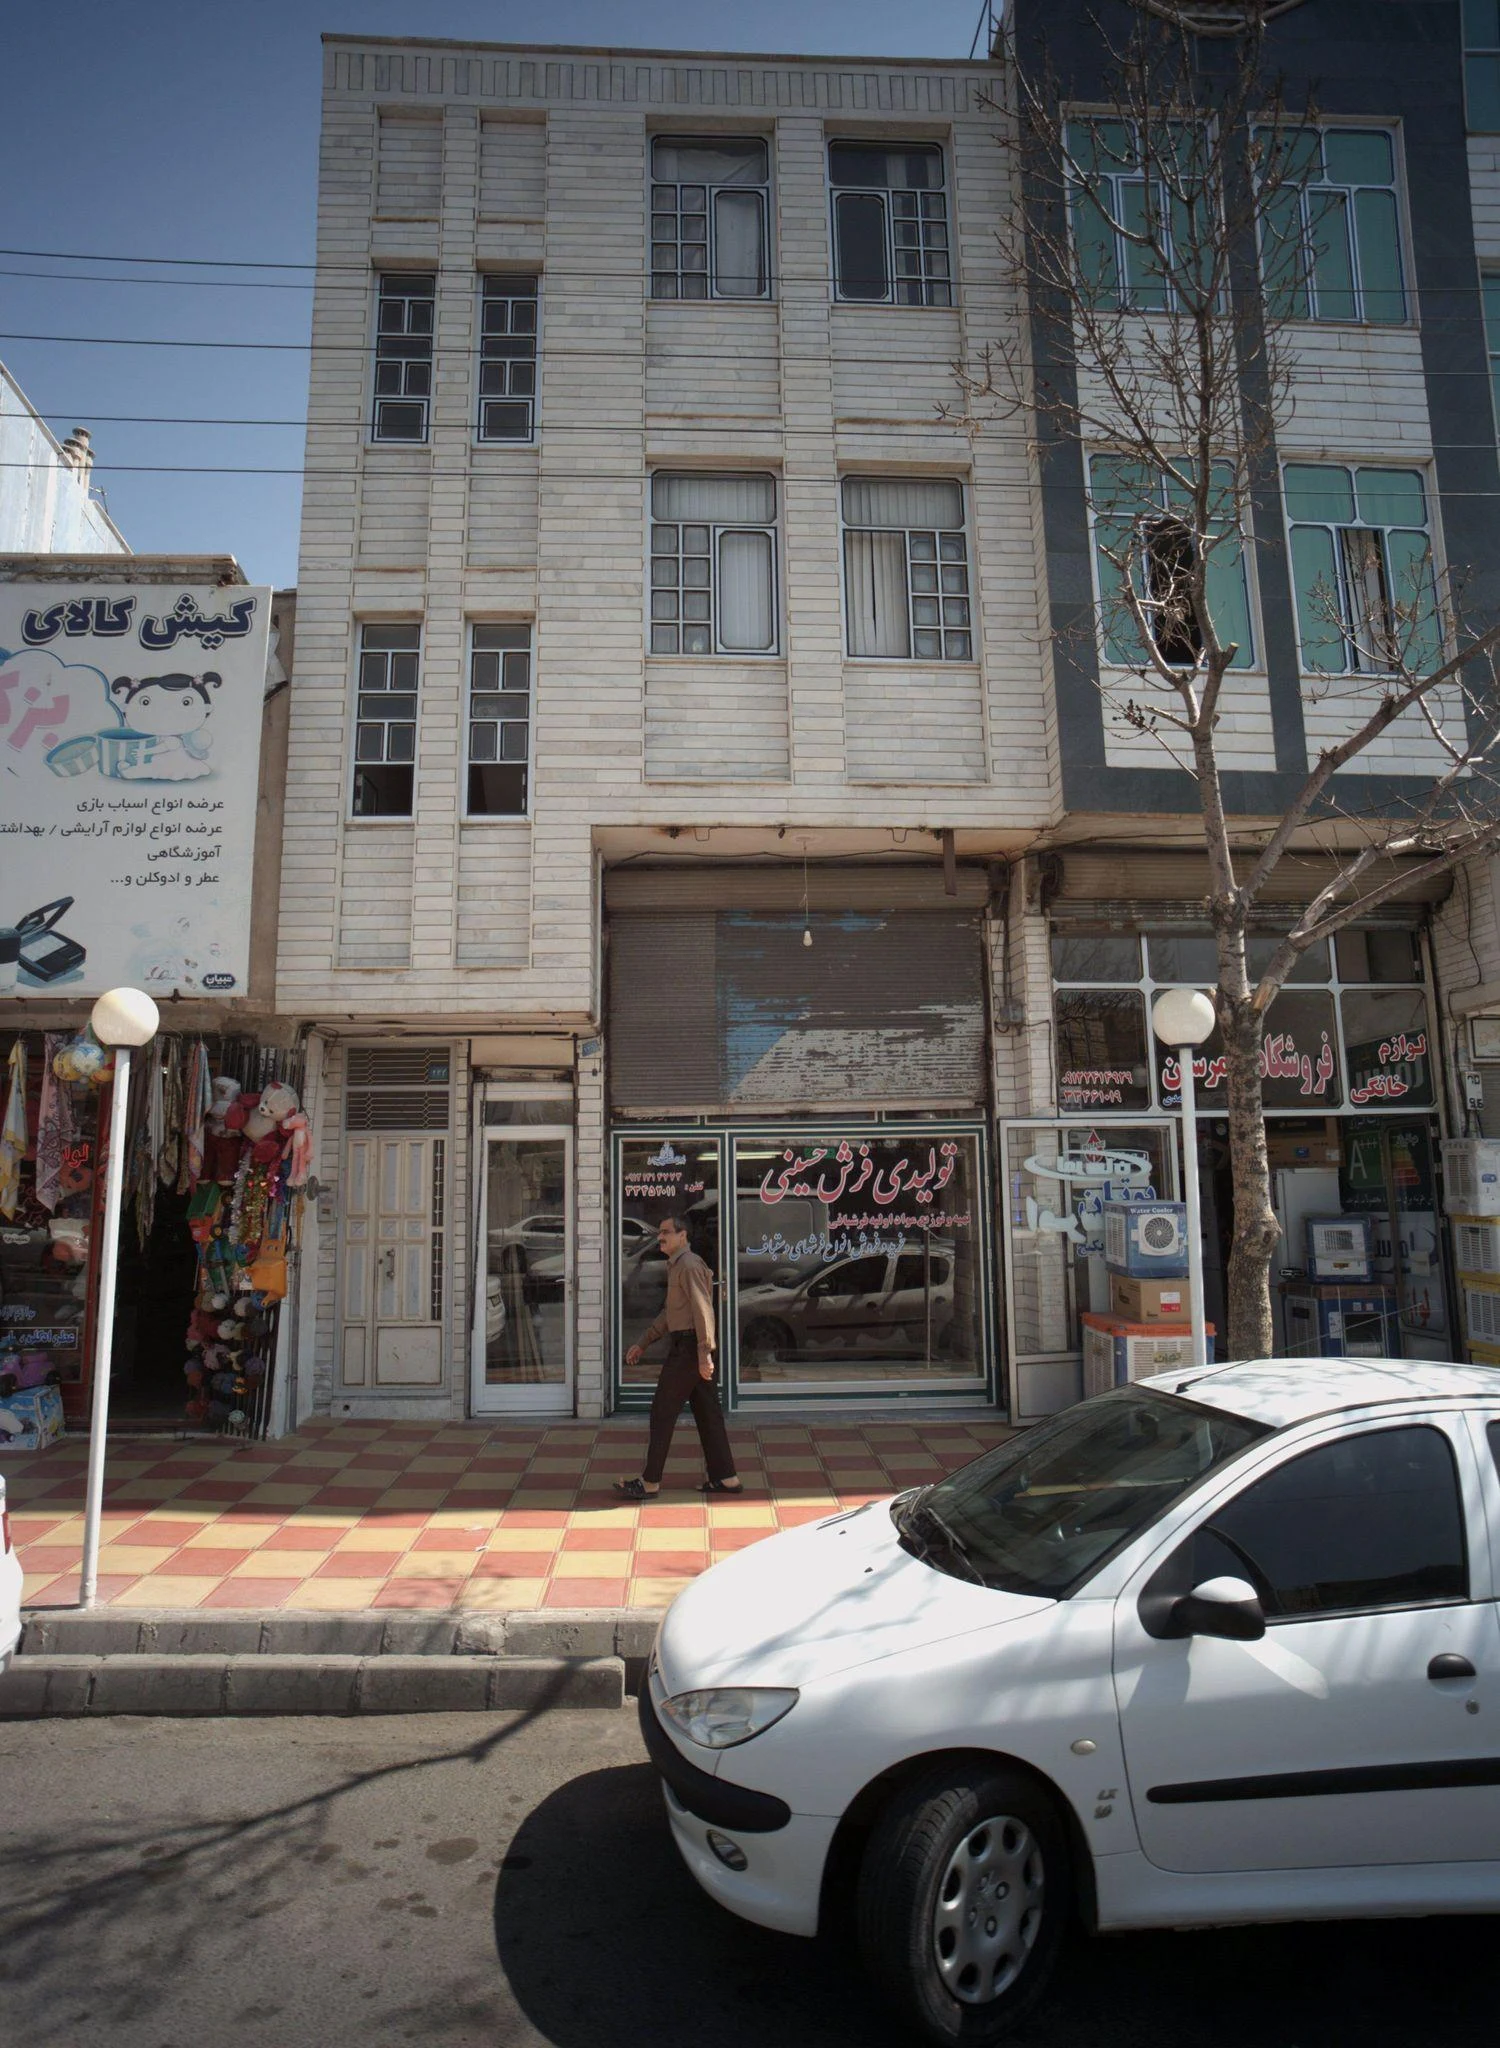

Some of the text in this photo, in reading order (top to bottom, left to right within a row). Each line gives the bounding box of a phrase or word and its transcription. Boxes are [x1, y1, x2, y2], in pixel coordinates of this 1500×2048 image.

[22, 593, 257, 650] کیش کالای
[76, 797, 224, 815] عرضه انواع اسباب بازی
[61, 820, 110, 837] آرایشی
[112, 822, 147, 837] لوازم
[150, 823, 181, 840] انواع
[185, 822, 223, 836] عرضه
[147, 845, 222, 862] آموزشگاهی
[136, 871, 180, 886] ادکلن
[184, 875, 192, 886] و
[196, 871, 220, 886] عطر
[1378, 1034, 1426, 1064] لوازم
[1351, 1074, 1409, 1103] خانگی
[760, 1148, 828, 1205] حسینی
[817, 1140, 874, 1204] فرش
[873, 1142, 958, 1205] تولیدی
